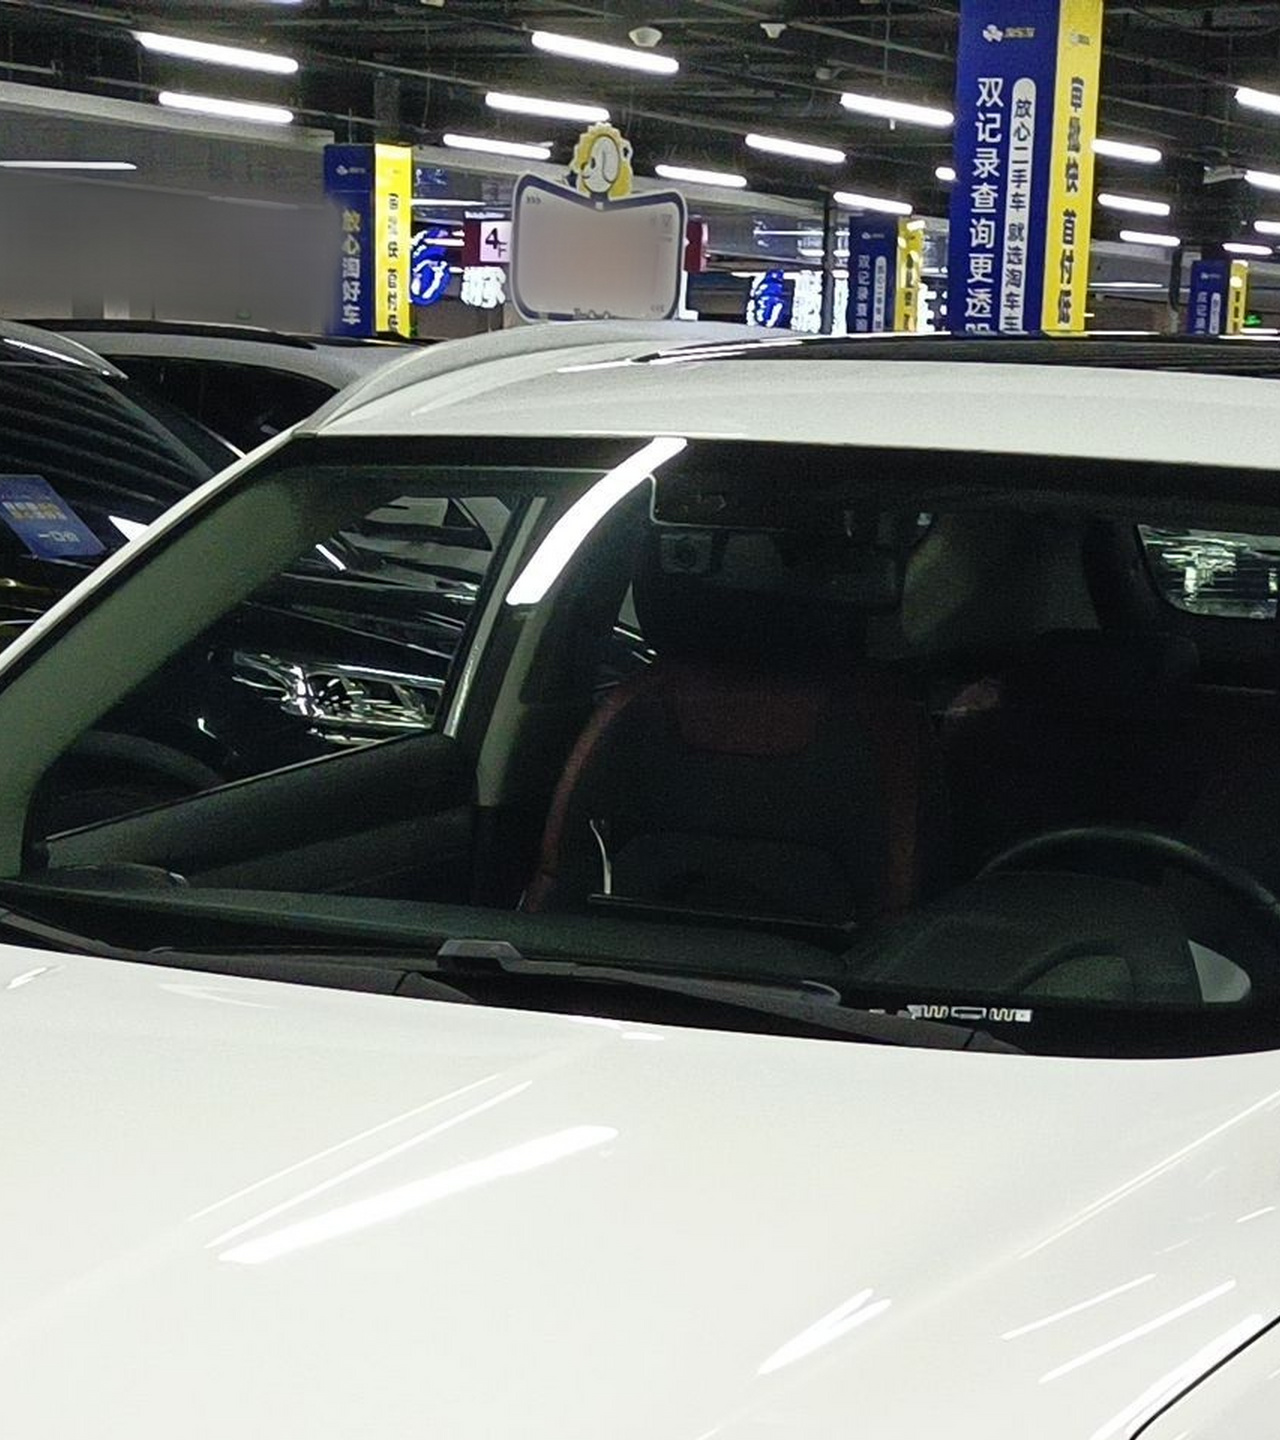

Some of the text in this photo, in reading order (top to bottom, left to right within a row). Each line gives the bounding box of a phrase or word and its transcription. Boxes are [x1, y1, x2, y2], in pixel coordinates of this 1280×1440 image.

[1009, 97, 1033, 212] 放心二手车
